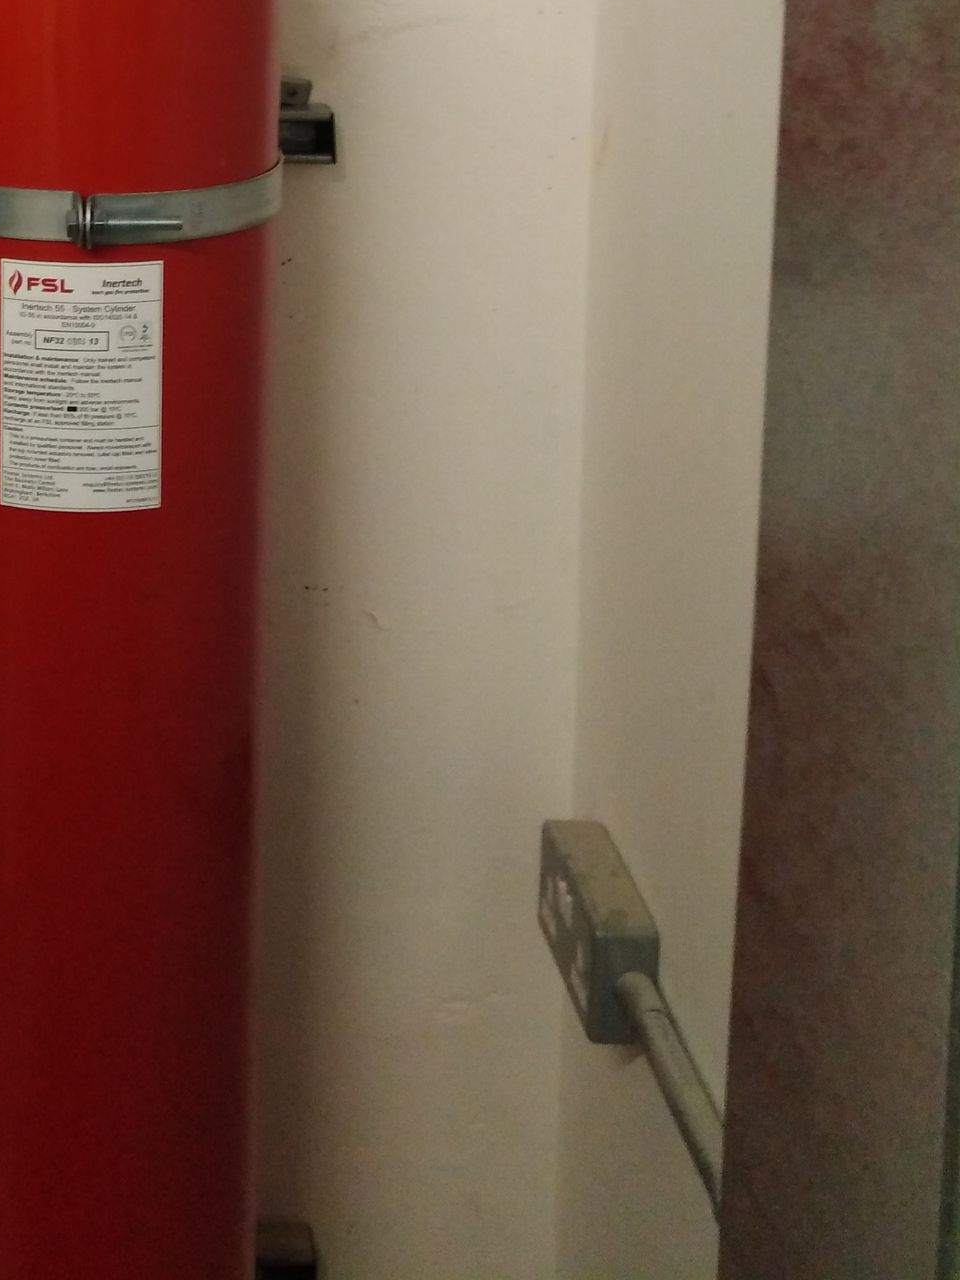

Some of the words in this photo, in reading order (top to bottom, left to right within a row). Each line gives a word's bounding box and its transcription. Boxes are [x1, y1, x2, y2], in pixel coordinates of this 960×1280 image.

[26, 277, 74, 294] FSL
[102, 278, 142, 288] Inertech
[22, 302, 52, 312] Inertech
[72, 305, 102, 314] System
[104, 305, 136, 314] Cylinder
